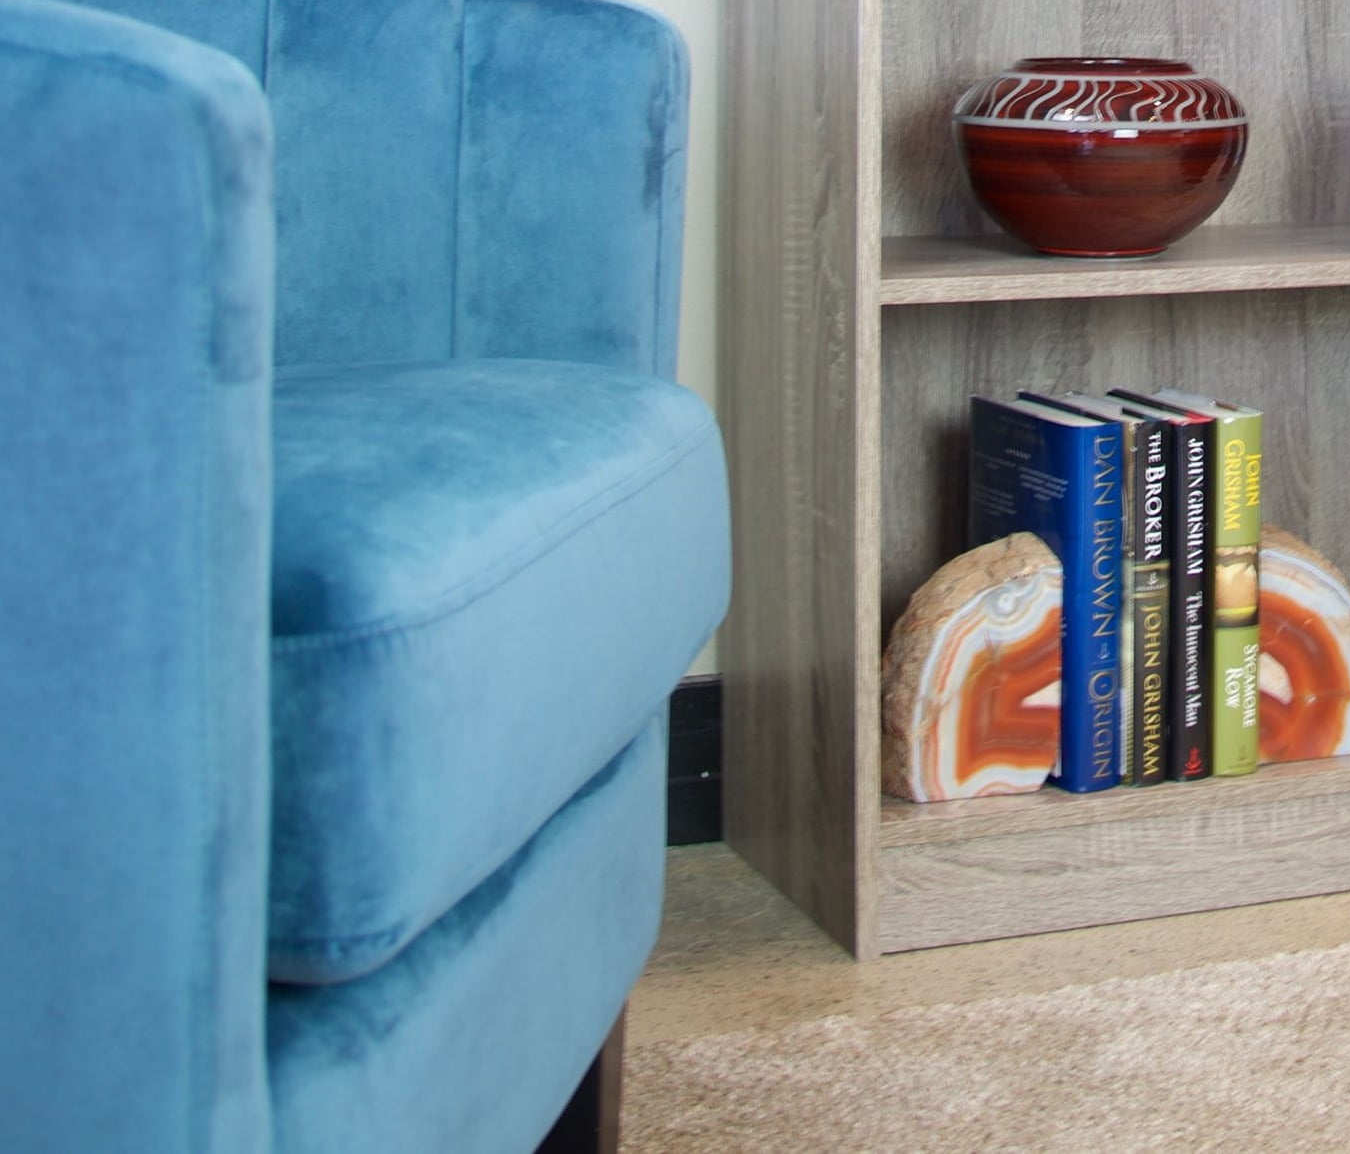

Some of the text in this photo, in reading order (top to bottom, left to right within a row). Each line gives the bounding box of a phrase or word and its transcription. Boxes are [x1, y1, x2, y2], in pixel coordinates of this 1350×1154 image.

[1147, 431, 1162, 463] THE
[1223, 439, 1246, 530] GRISHAM
[1246, 453, 1262, 506] JOHN
[1092, 435, 1117, 638] DAN BROWN
[1144, 465, 1167, 562] BROKER
[1187, 437, 1205, 575] JOHN GRISHAM
[1140, 604, 1161, 668] JOHN
[1184, 590, 1203, 727] The Innocent Man
[1088, 668, 1118, 779] ORIGIN
[1143, 673, 1161, 777] GRISHAM
[1242, 643, 1259, 728] SYCAMORE
